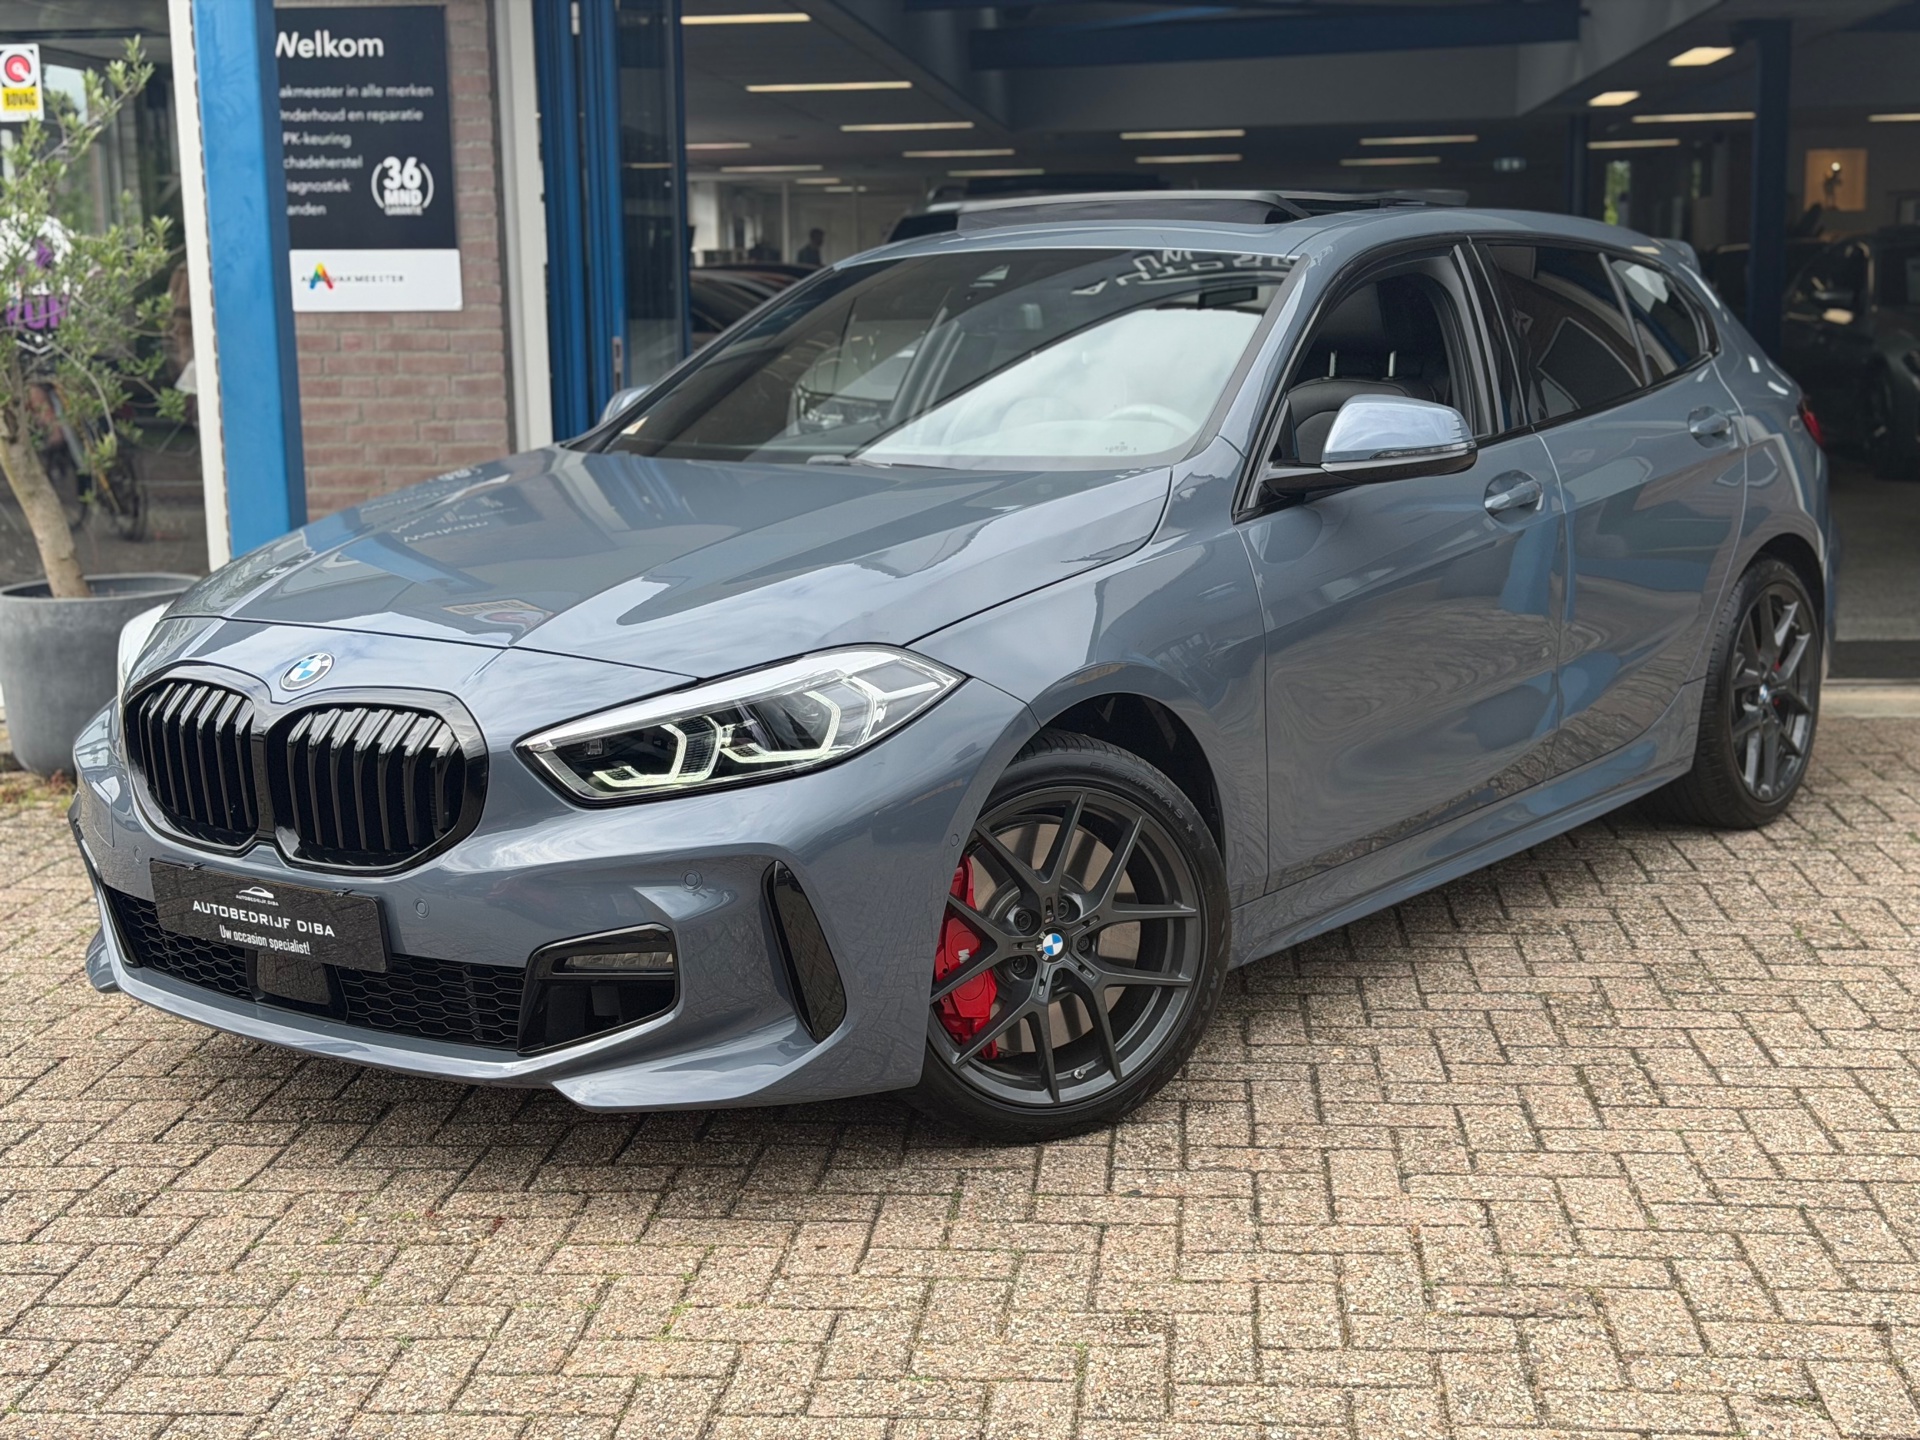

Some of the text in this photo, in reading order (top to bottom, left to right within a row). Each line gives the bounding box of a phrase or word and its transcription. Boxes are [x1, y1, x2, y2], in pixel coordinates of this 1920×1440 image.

[279, 83, 434, 99] akmeester in alle merken
[280, 108, 424, 124] nderhoud en reparatie
[283, 131, 352, 148] PK-keuring
[283, 155, 363, 169] chadeherstel
[383, 156, 422, 190] 36
[286, 179, 351, 196] iagnostiek
[286, 202, 326, 216] anden
[192, 900, 336, 937] AUTOBEDRIJF DIBA
[219, 924, 311, 956] Uw occasion specialist!
